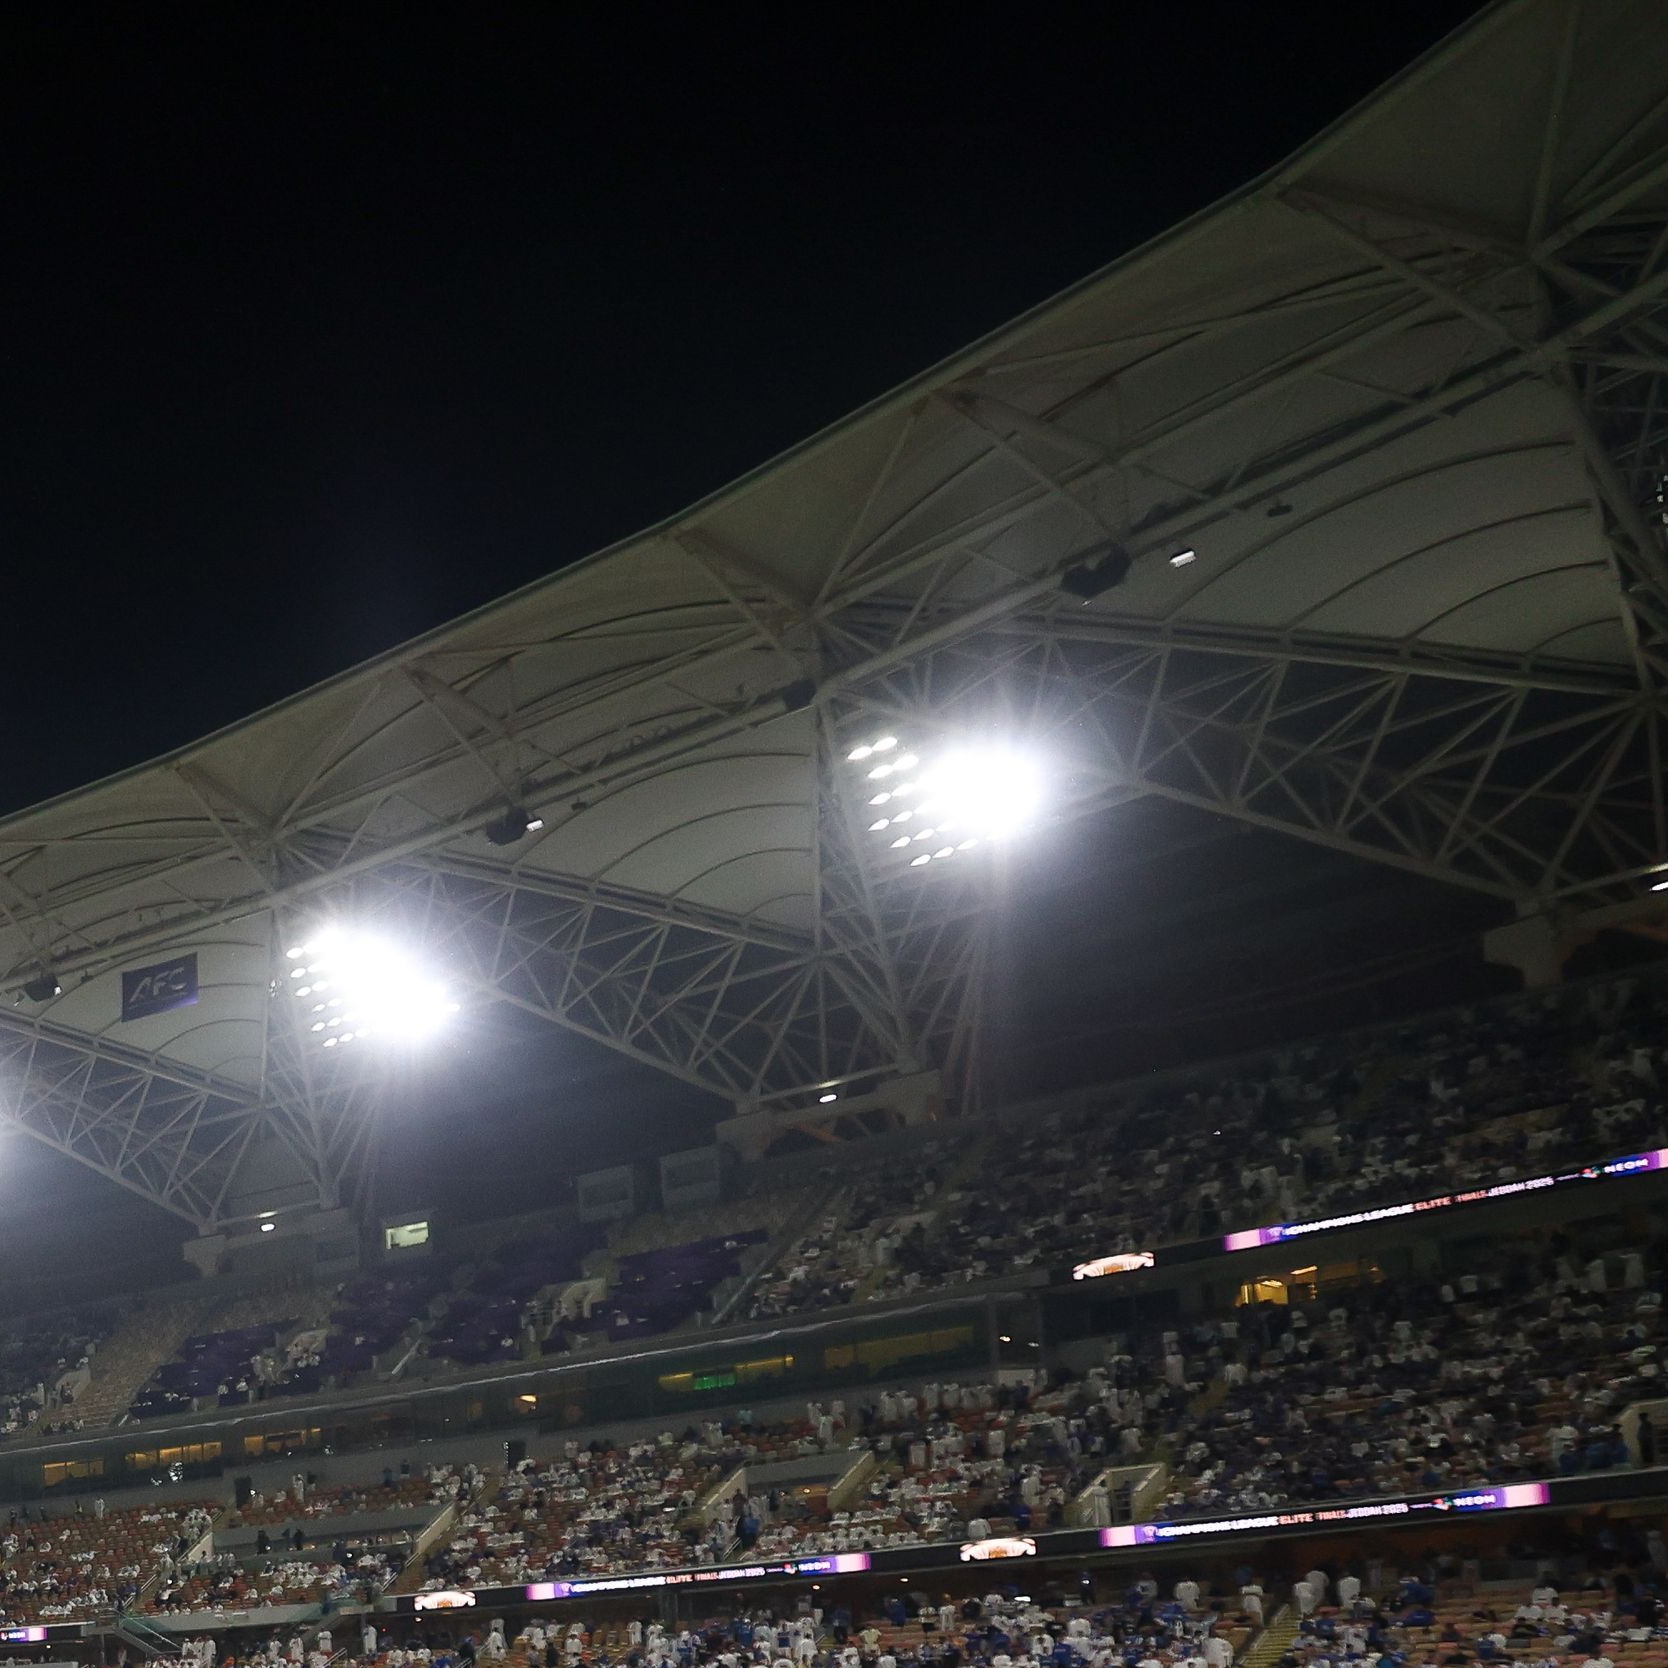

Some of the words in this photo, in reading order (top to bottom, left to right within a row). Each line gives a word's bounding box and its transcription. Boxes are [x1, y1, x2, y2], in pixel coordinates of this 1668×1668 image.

[1415, 1196, 1453, 1212] ELITE
[1604, 1158, 1649, 1174] NEOM
[1279, 1512, 1314, 1525] ELITE
[1452, 1493, 1497, 1507] NEOM
